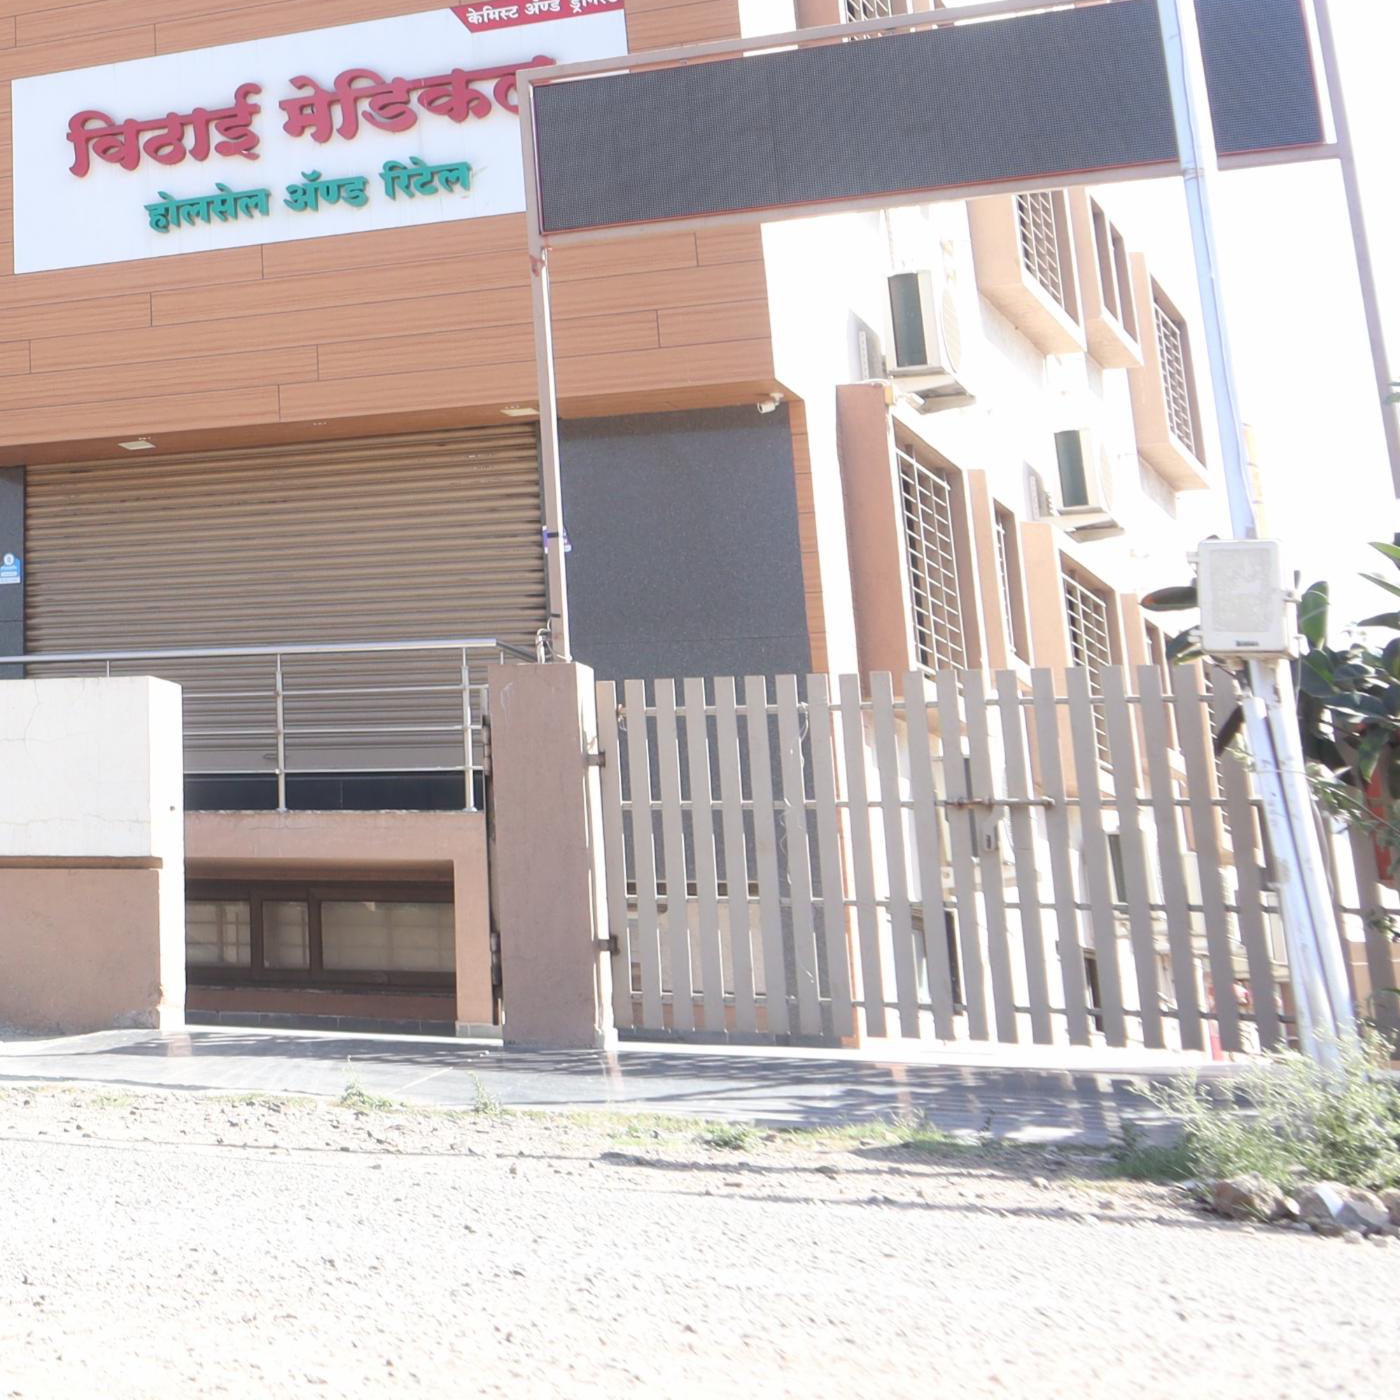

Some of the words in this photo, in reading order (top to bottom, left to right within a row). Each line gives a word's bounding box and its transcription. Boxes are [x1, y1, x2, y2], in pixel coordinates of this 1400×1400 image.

[466, 7, 519, 25] केमिस्ट
[66, 82, 263, 179] विठाई
[144, 182, 271, 234] होलसेल
[379, 156, 474, 201] रिटेल
